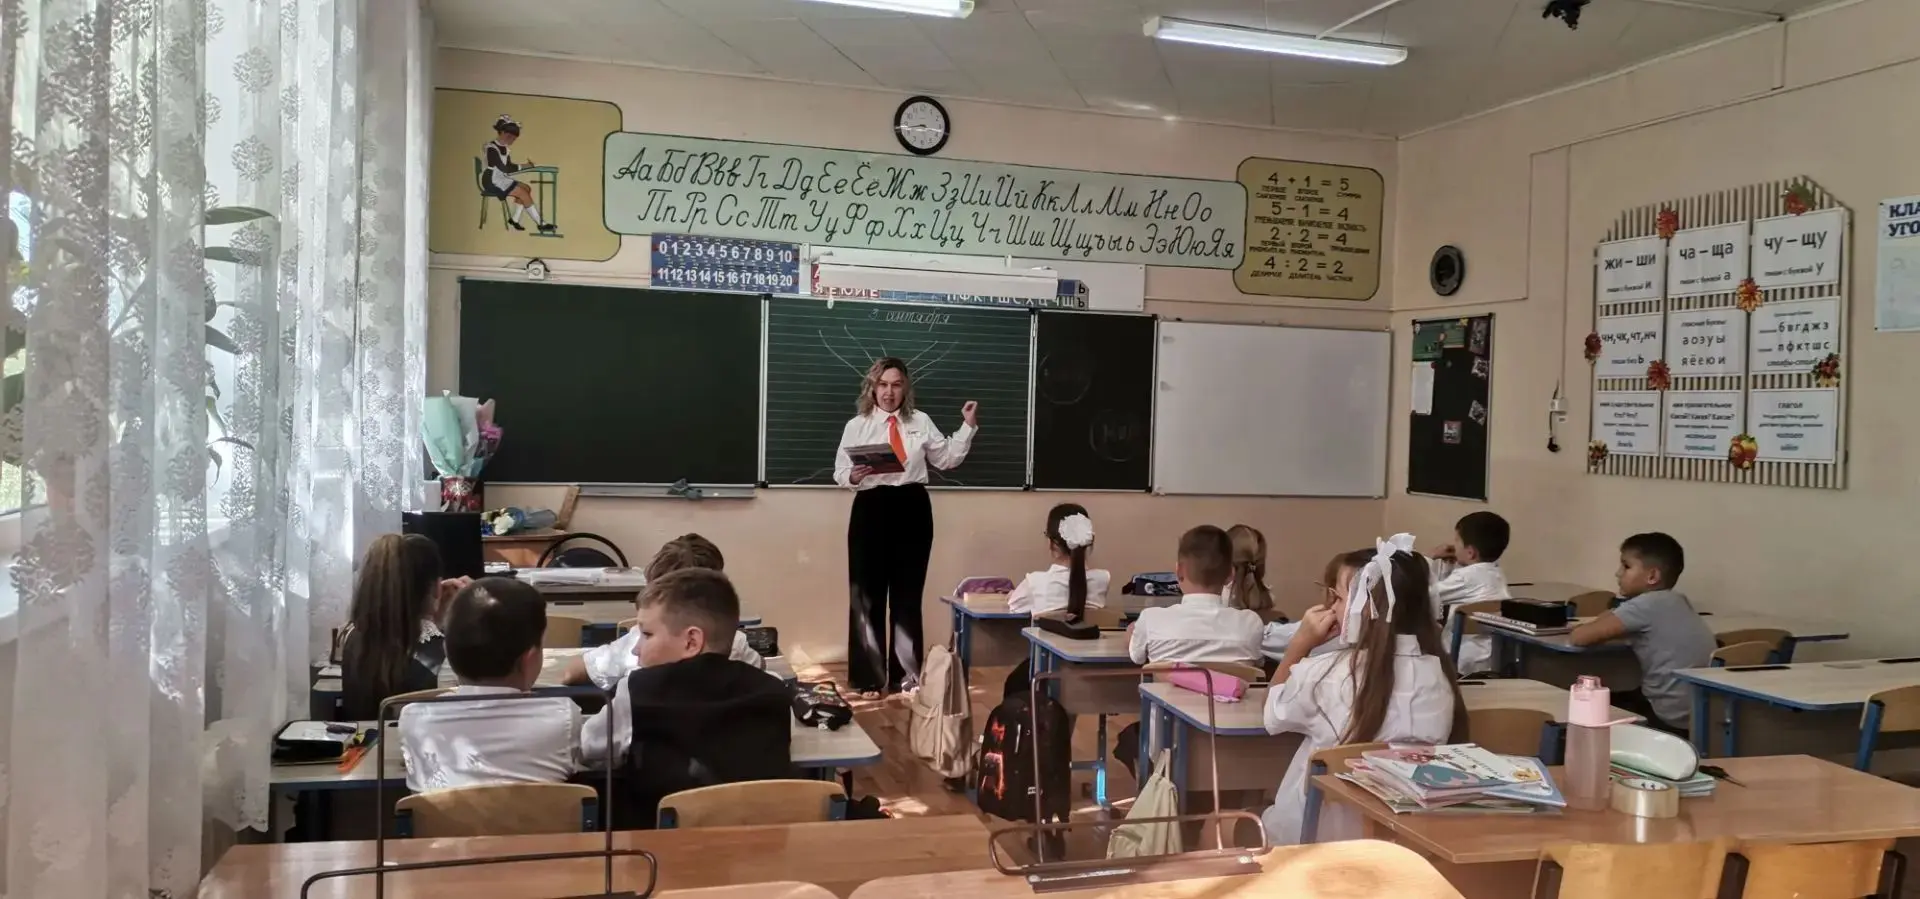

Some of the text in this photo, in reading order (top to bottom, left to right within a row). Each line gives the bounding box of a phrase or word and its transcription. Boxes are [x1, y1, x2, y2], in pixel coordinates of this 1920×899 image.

[613, 147, 653, 180] Аа
[656, 149, 698, 184] Бб
[743, 155, 769, 189] Гг
[818, 161, 848, 194] Ее
[851, 162, 880, 197] Ёё
[879, 167, 929, 202] Жж
[931, 172, 959, 210] Зз
[960, 173, 991, 206] Ии
[994, 174, 1029, 209] Йй
[1031, 180, 1062, 212] Кк
[1060, 183, 1093, 215] Лл
[1095, 186, 1138, 217] Мм
[1144, 189, 1180, 220] Нн
[1182, 192, 1213, 222] Оо
[1267, 172, 1279, 185] 4
[1303, 175, 1311, 188] 1
[1339, 178, 1349, 191] 5
[1271, 201, 1282, 215] 5
[1302, 204, 1310, 217] 1
[1337, 207, 1349, 221] 4
[638, 189, 677, 223] Пп
[680, 191, 709, 234] Рр
[715, 194, 750, 227] Сс
[752, 196, 799, 231] Тт
[804, 200, 839, 243] Уу
[843, 202, 885, 245] Фф
[888, 206, 927, 240] Хх
[930, 209, 965, 249] Цц
[971, 212, 1002, 244] Чч
[1006, 214, 1046, 247] Шш
[1140, 223, 1167, 254] Ээ
[1168, 225, 1206, 257] Юю
[1204, 228, 1236, 258] Яя
[1270, 227, 1280, 240] 2
[1299, 229, 1310, 242] 2
[1336, 233, 1347, 245] 4
[1764, 236, 1783, 255] чу
[1802, 230, 1828, 249] щу
[659, 241, 793, 263] 0 1 2 3 4 5 6 7 8 9 10
[1680, 247, 1696, 260] ча
[1712, 242, 1734, 259] ща
[1264, 256, 1276, 269] 4
[1298, 258, 1308, 271] 2
[1333, 261, 1344, 274] 2
[658, 267, 793, 287] 11 12 13 14 15 16 17 18 19 20
